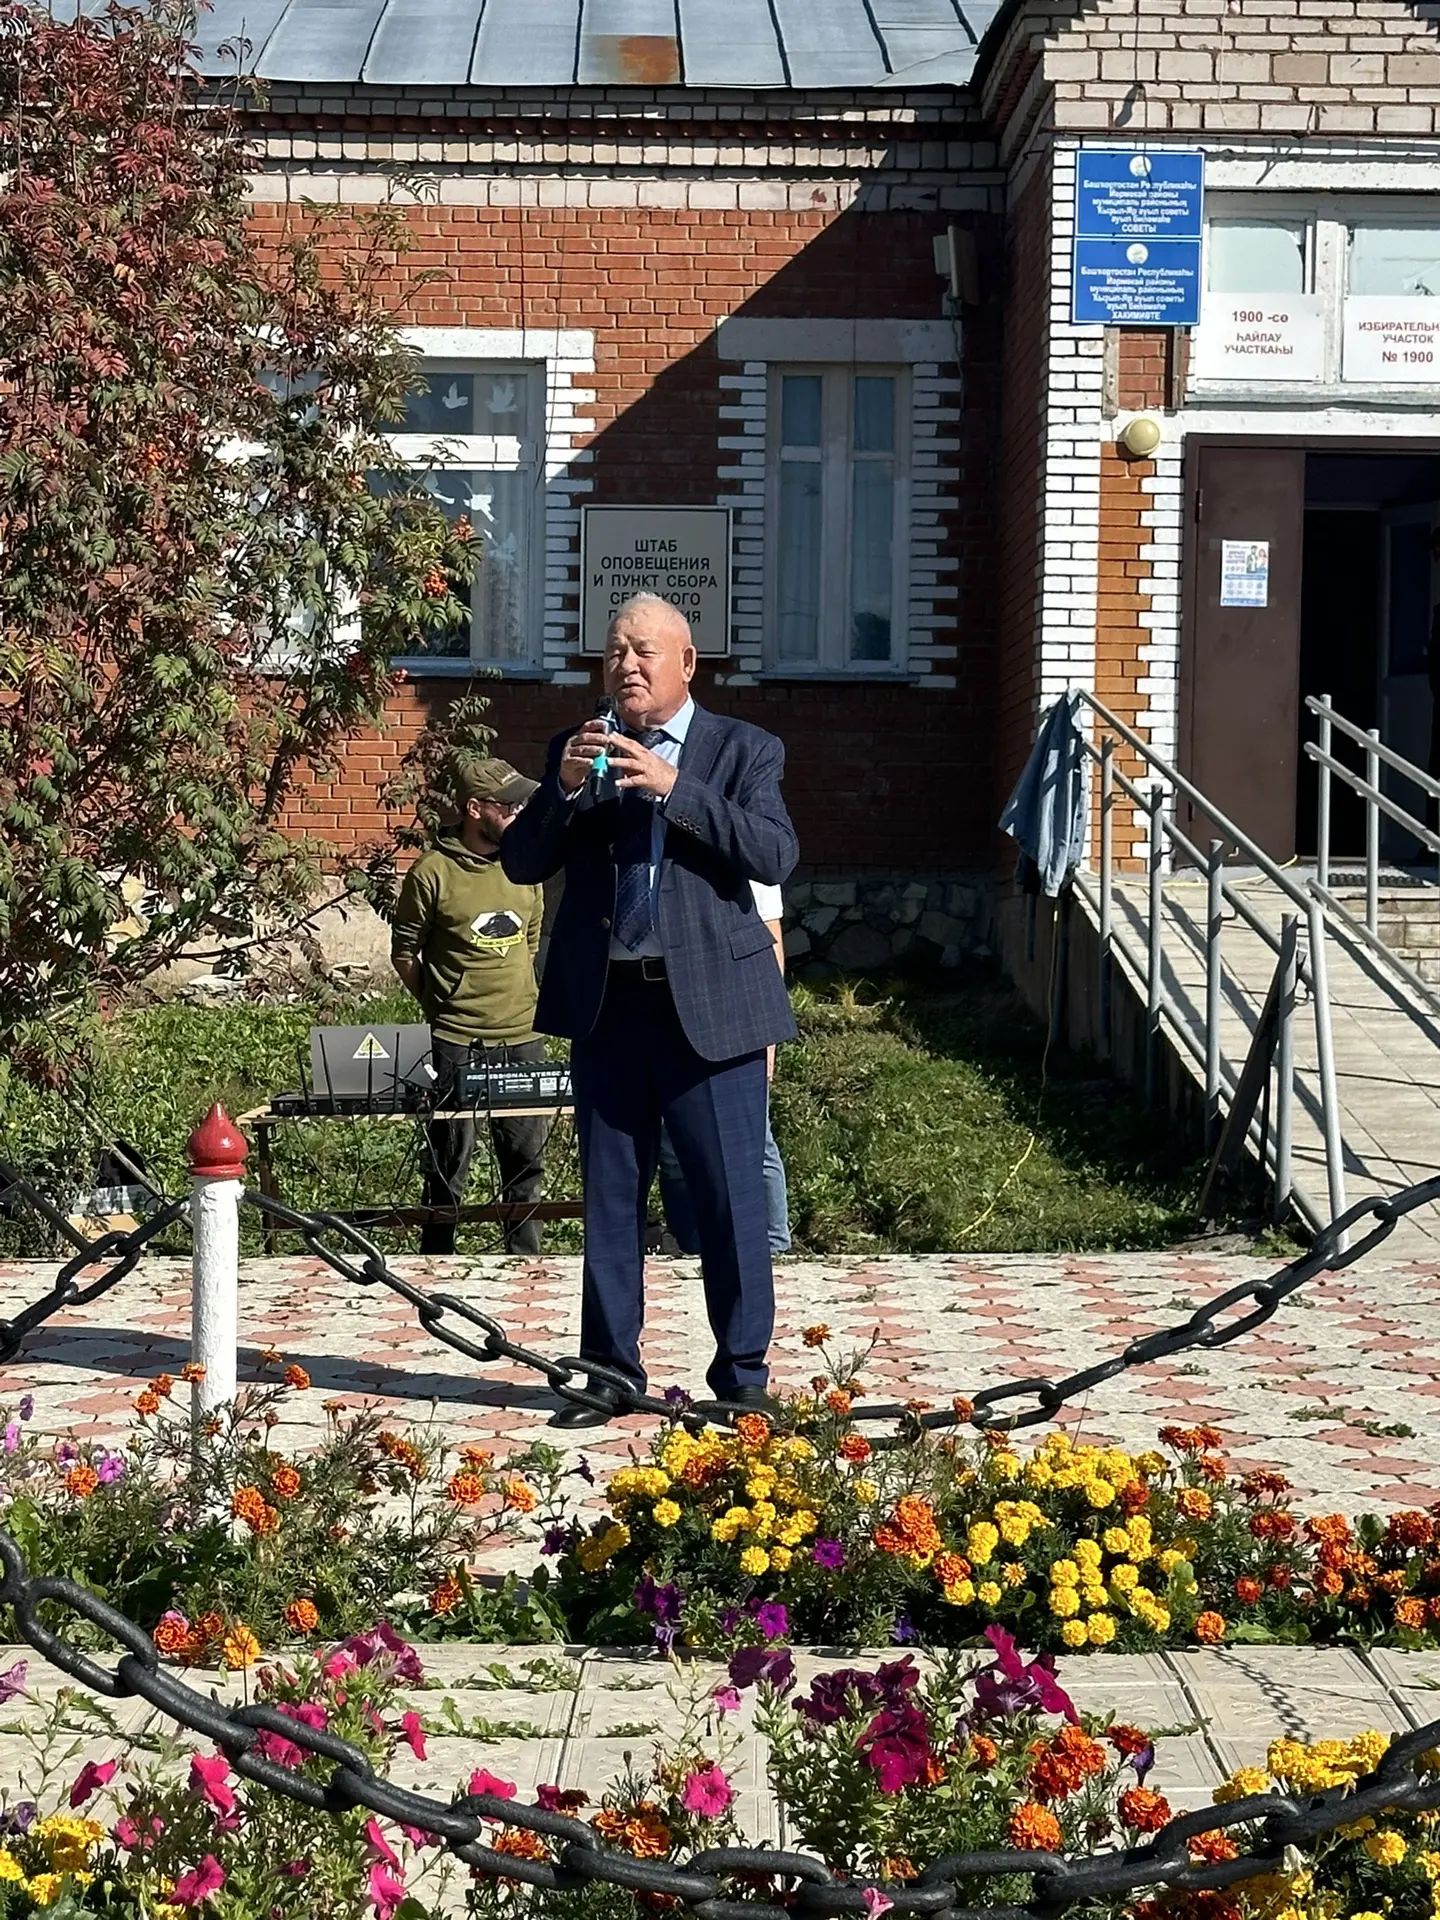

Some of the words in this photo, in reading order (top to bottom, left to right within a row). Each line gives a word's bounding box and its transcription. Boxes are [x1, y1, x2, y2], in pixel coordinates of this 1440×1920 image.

[1121, 223, 1157, 233] СОВЕТЫ
[1232, 310, 1263, 322] 1900
[1382, 334, 1434, 344] УЧАСТОК
[1382, 351, 1398, 363] №
[1403, 351, 1434, 363] 1900
[635, 539, 678, 553] ШТАБ
[601, 556, 710, 572] ОПОВЕЩЕНИЯ
[593, 574, 604, 587] И
[611, 574, 659, 588] ПУНКТ
[666, 574, 718, 588] СБОРА
